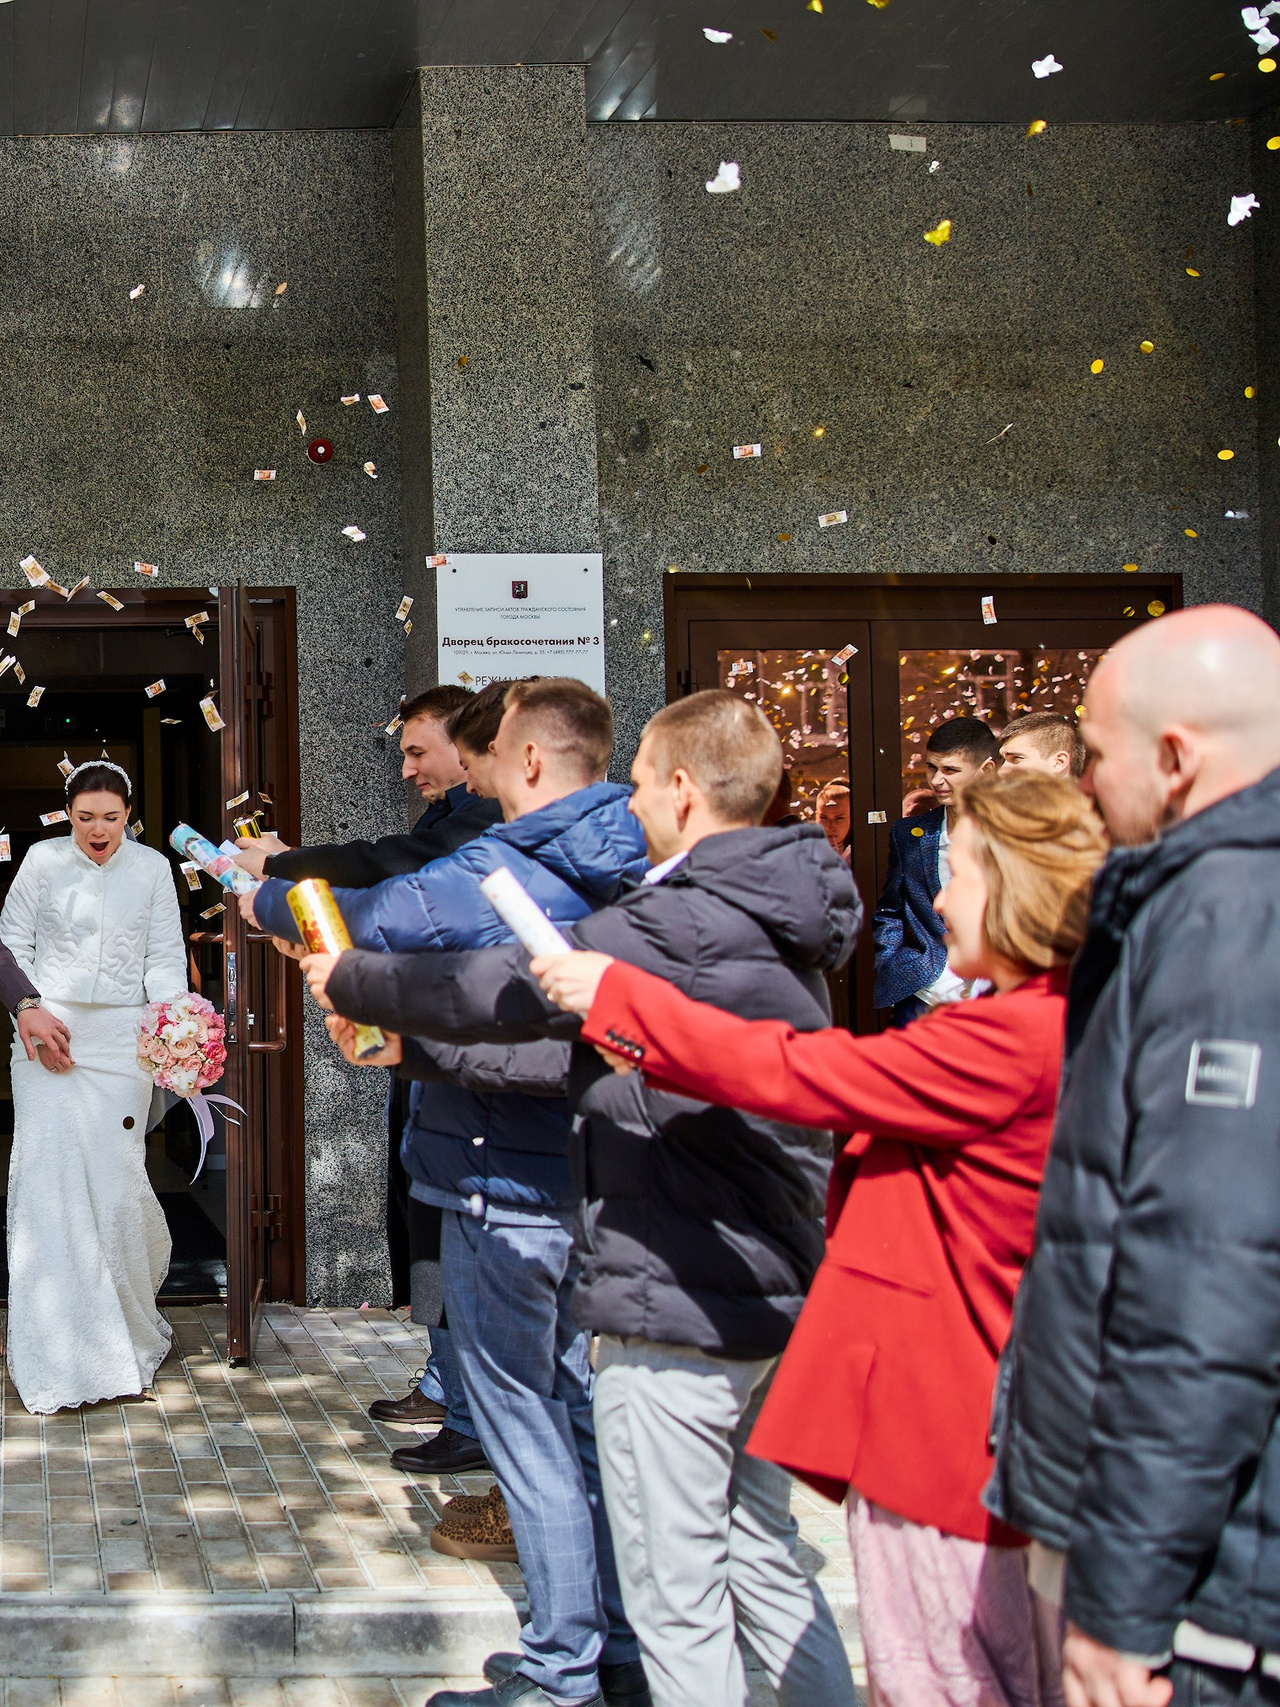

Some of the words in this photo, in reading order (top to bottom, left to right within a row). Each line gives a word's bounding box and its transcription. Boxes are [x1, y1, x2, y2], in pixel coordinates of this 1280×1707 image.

[442, 637, 484, 648] Дворец
[486, 636, 574, 648] бракосочетания
[577, 636, 590, 645] №
[593, 636, 600, 645] 3
